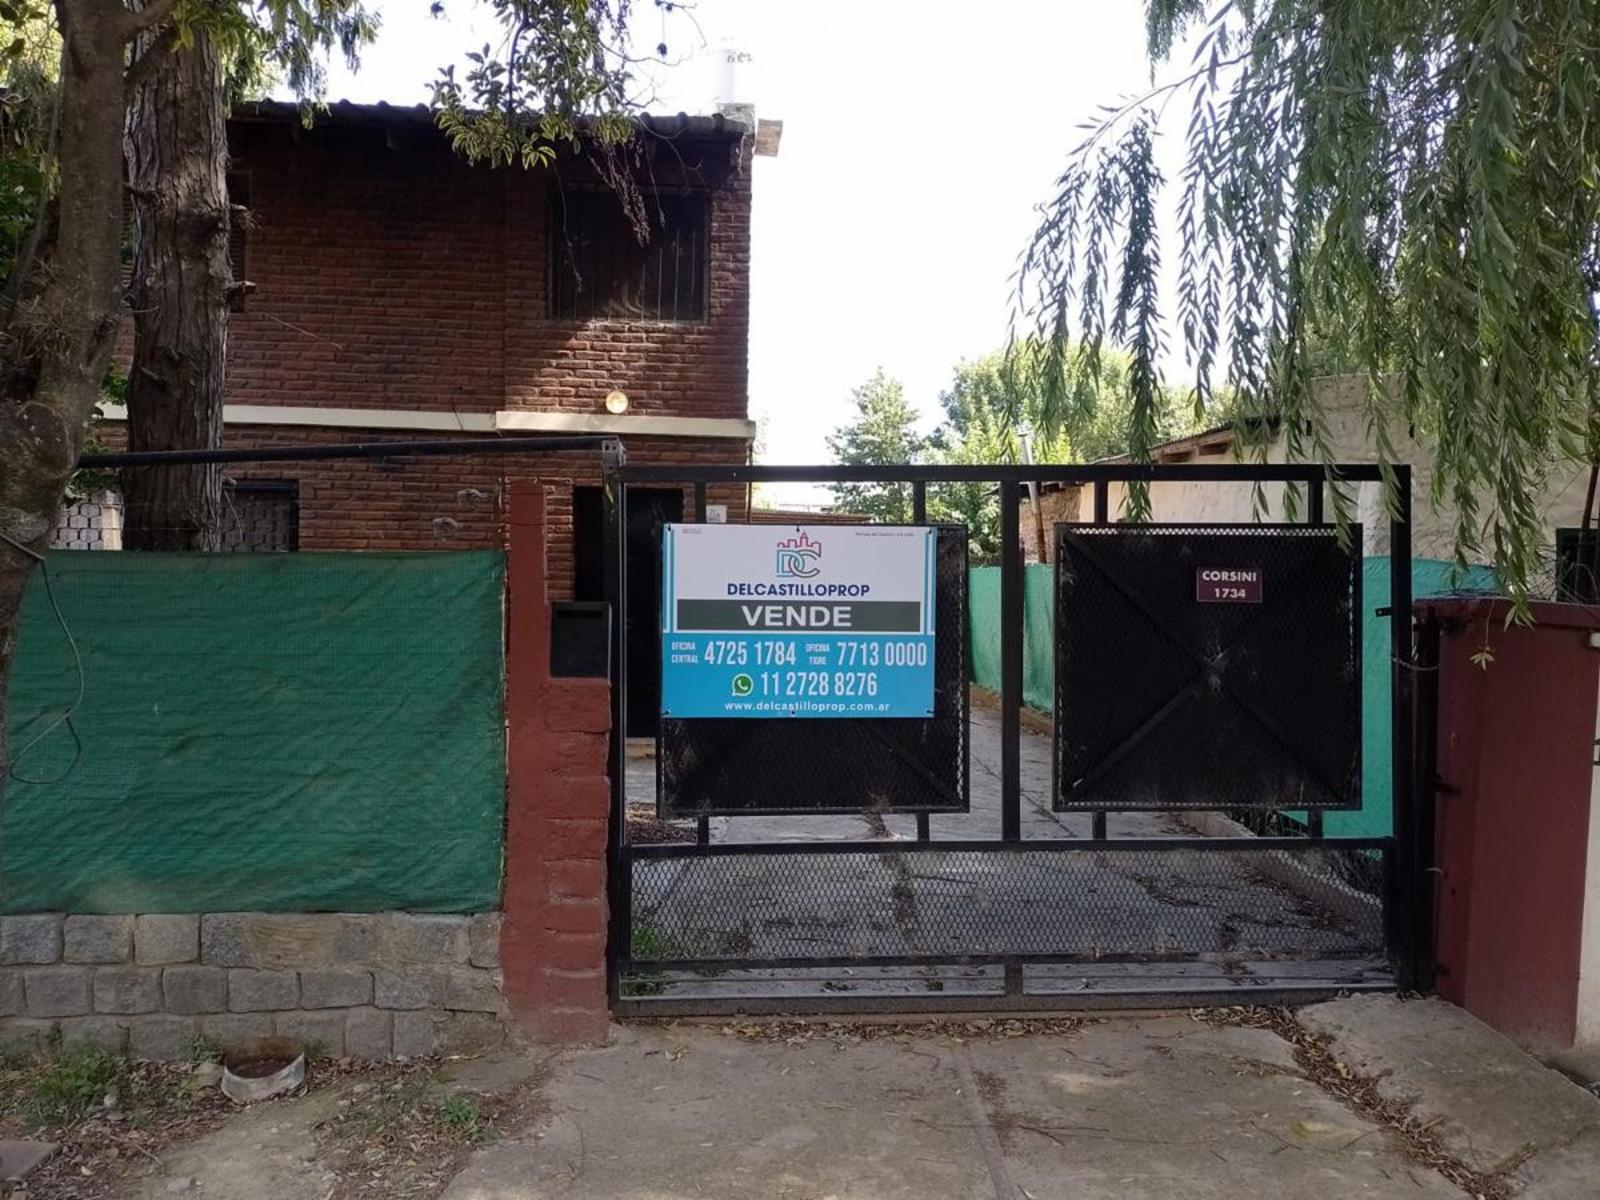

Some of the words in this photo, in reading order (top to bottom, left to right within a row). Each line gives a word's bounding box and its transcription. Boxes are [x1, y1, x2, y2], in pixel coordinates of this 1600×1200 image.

[1202, 570, 1257, 582] CORSINI
[727, 583, 870, 597] DELCASTILLOPROP
[1214, 587, 1246, 598] 1734
[741, 605, 852, 627] VENDE
[671, 641, 696, 651] OFICINA
[805, 643, 830, 653] OFICINA
[671, 654, 698, 664] CENTRAL
[704, 641, 747, 665] 4725
[754, 641, 796, 666] 1784
[837, 642, 879, 666] 7713
[885, 642, 927, 667] 0000
[809, 656, 827, 665] TIGRE
[761, 671, 780, 696] 11
[786, 671, 829, 696] 2728
[834, 672, 878, 696] 8276
[724, 701, 890, 712] www.delcastilloprop.com.ar
